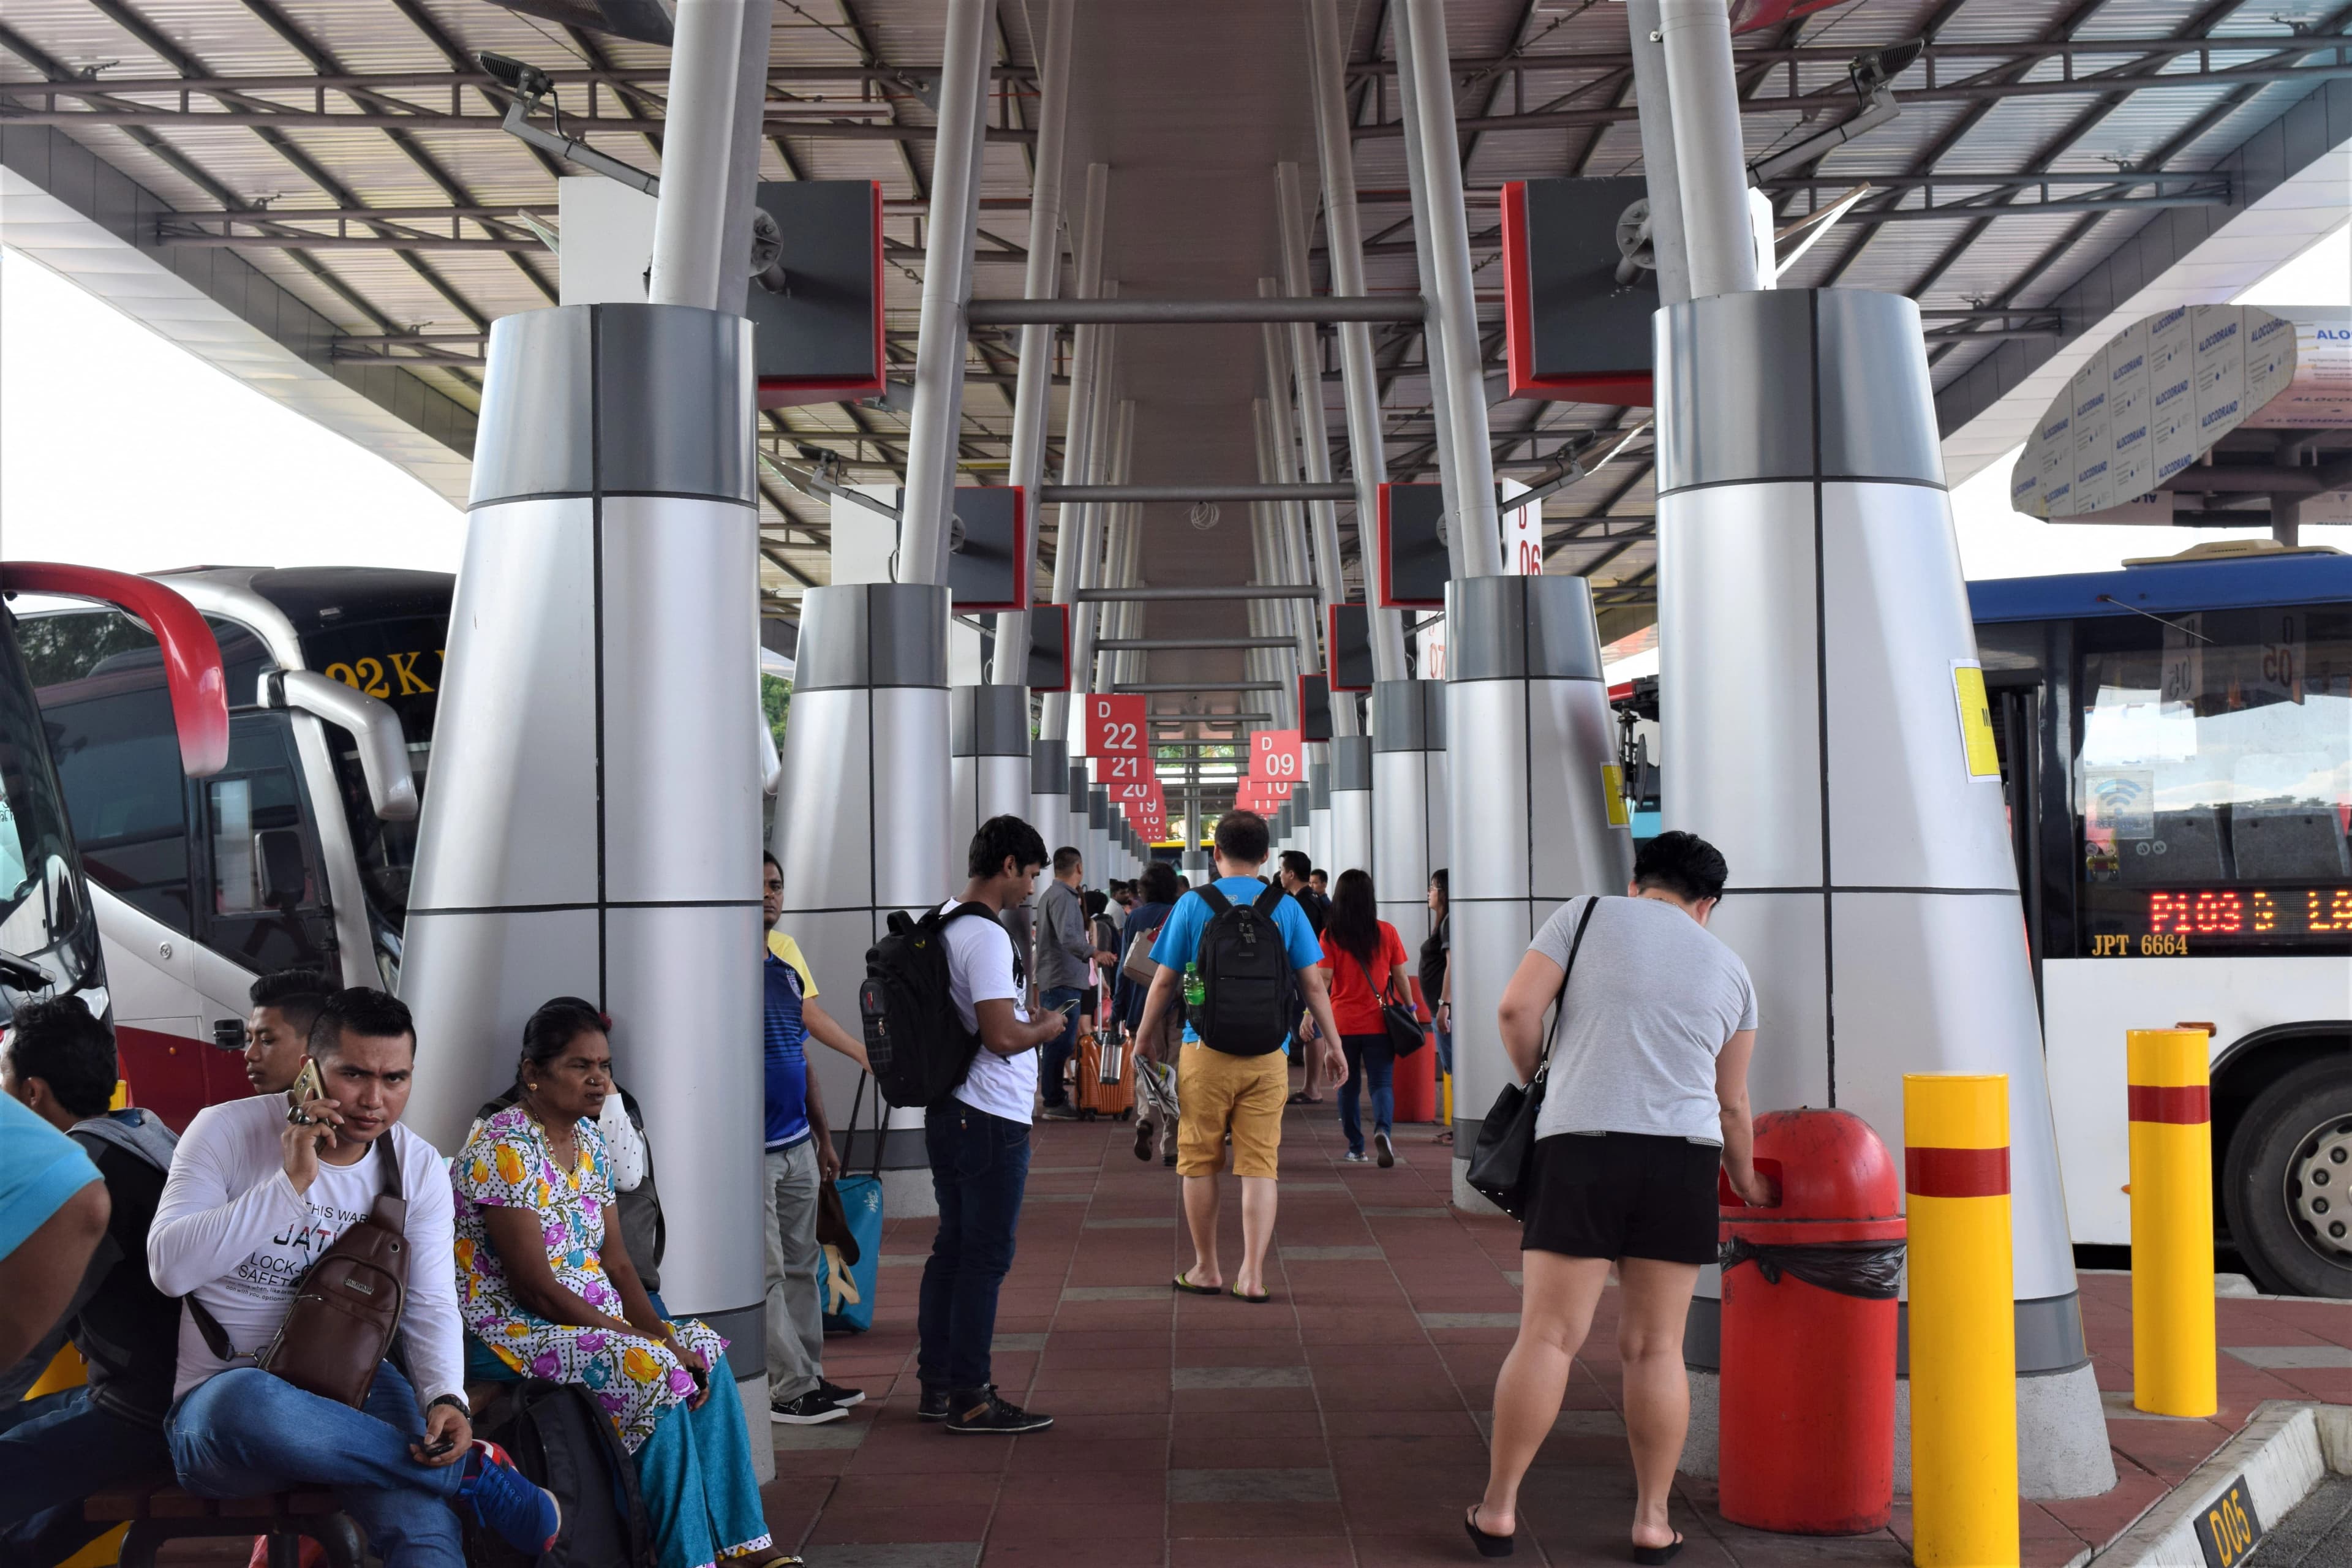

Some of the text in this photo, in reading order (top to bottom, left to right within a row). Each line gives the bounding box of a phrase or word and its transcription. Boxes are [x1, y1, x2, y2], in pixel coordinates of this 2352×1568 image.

[2317, 330, 2352, 340] ALO
[1520, 540, 1541, 575] 06
[1098, 701, 1110, 718] D
[1103, 723, 1137, 749] 22
[1262, 737, 1272, 750] D
[1112, 758, 1137, 777] 21
[1266, 753, 1294, 776] 09
[2092, 934, 2188, 956] JPT 6664
[2209, 1488, 2252, 1567] D05
